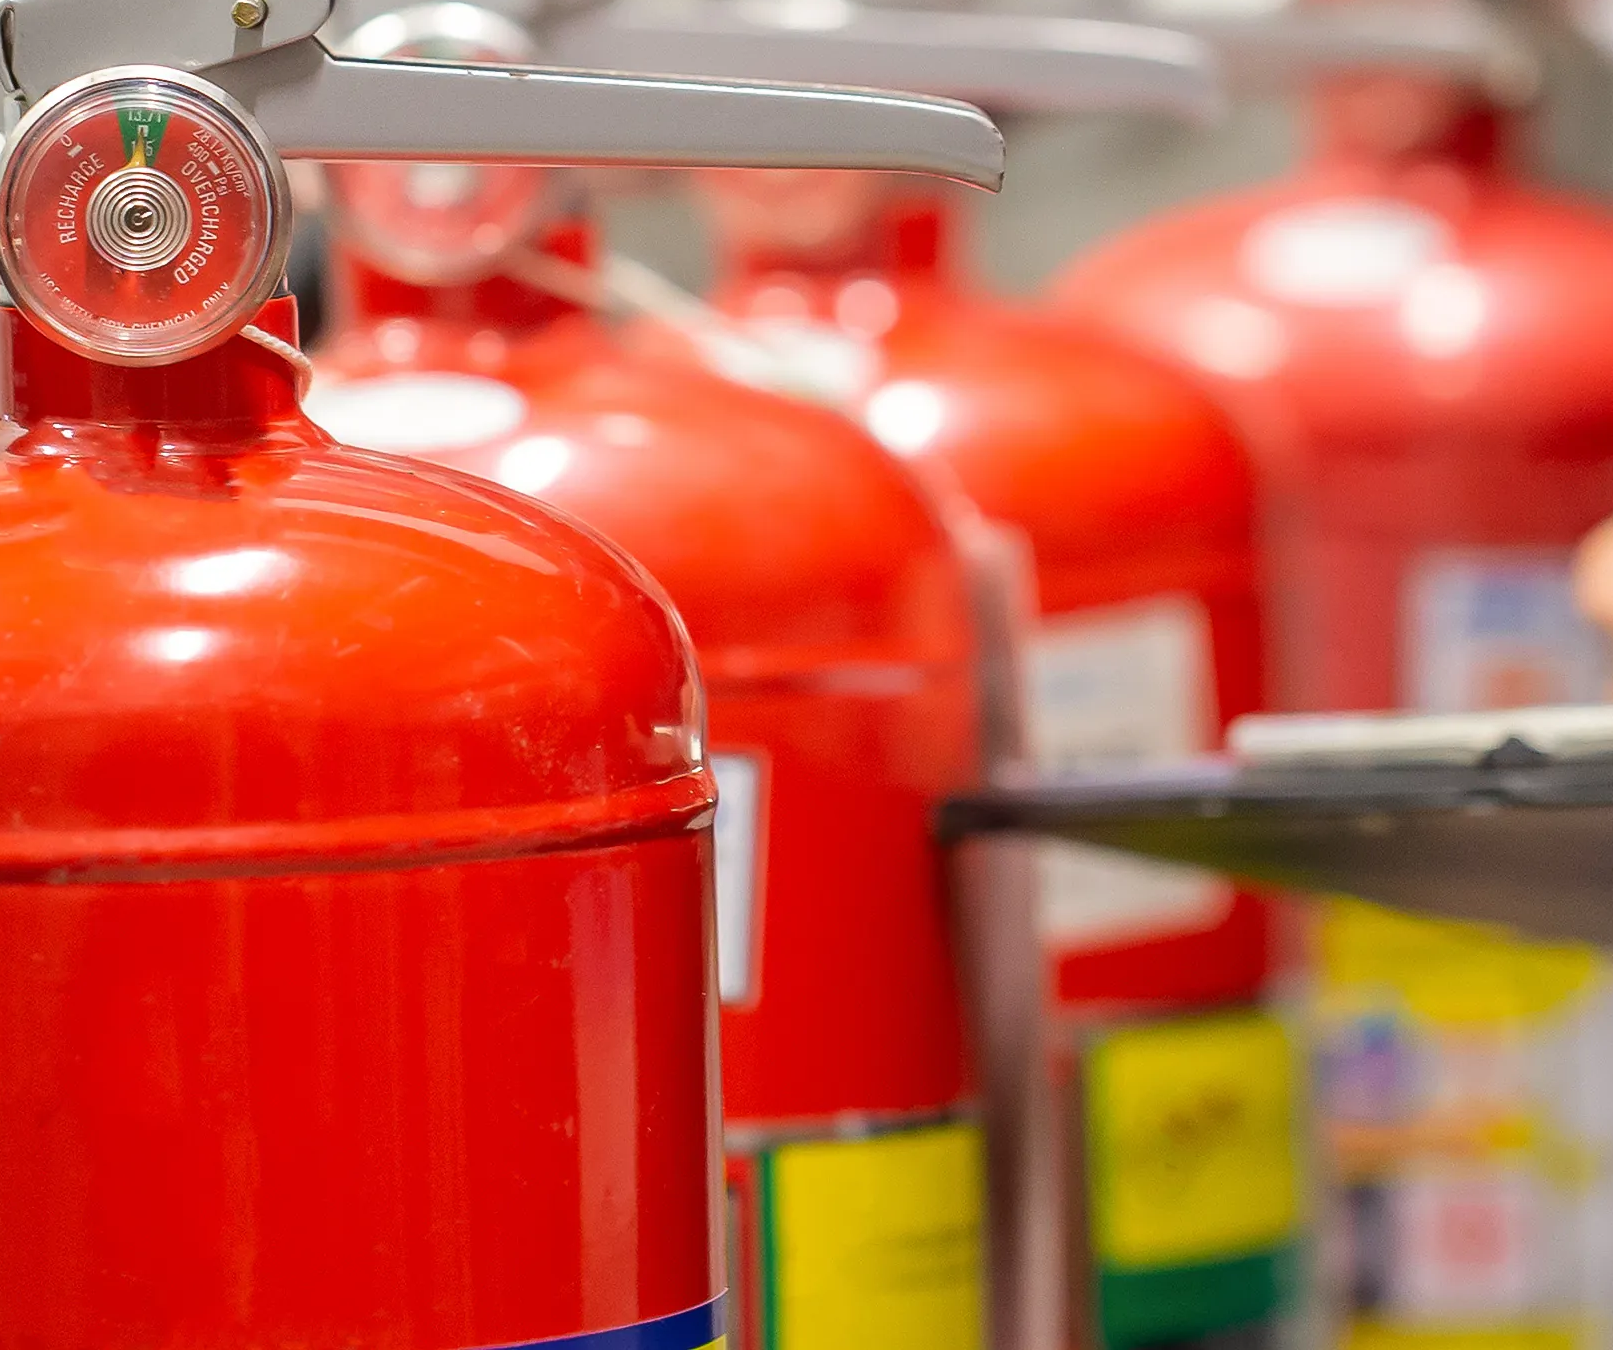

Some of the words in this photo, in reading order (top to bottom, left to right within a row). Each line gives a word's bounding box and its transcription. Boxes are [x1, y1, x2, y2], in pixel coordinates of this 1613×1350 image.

[131, 140, 155, 157] 15
[186, 142, 210, 163] 400
[57, 152, 105, 244] RECHARGE
[173, 160, 220, 284] OVERCHARGED
